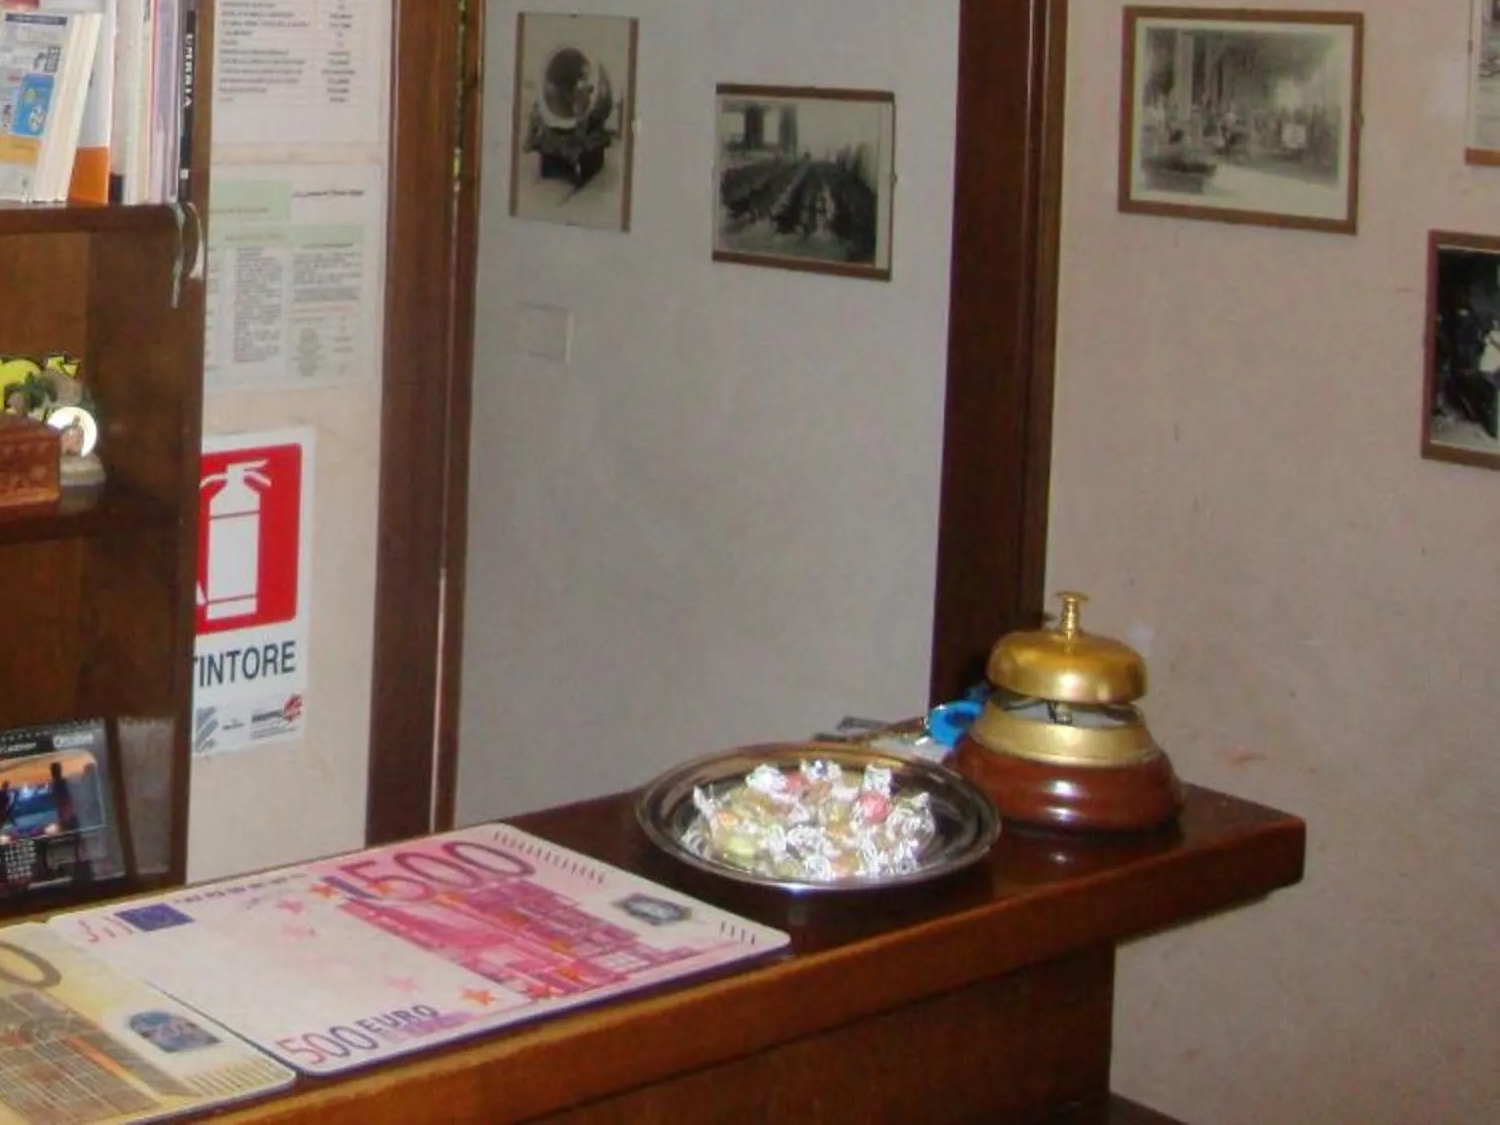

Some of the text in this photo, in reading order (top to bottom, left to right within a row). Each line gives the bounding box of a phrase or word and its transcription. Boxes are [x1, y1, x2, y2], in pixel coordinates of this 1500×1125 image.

[338, 840, 536, 903] 500
[275, 1004, 440, 1065] 500 EURO
